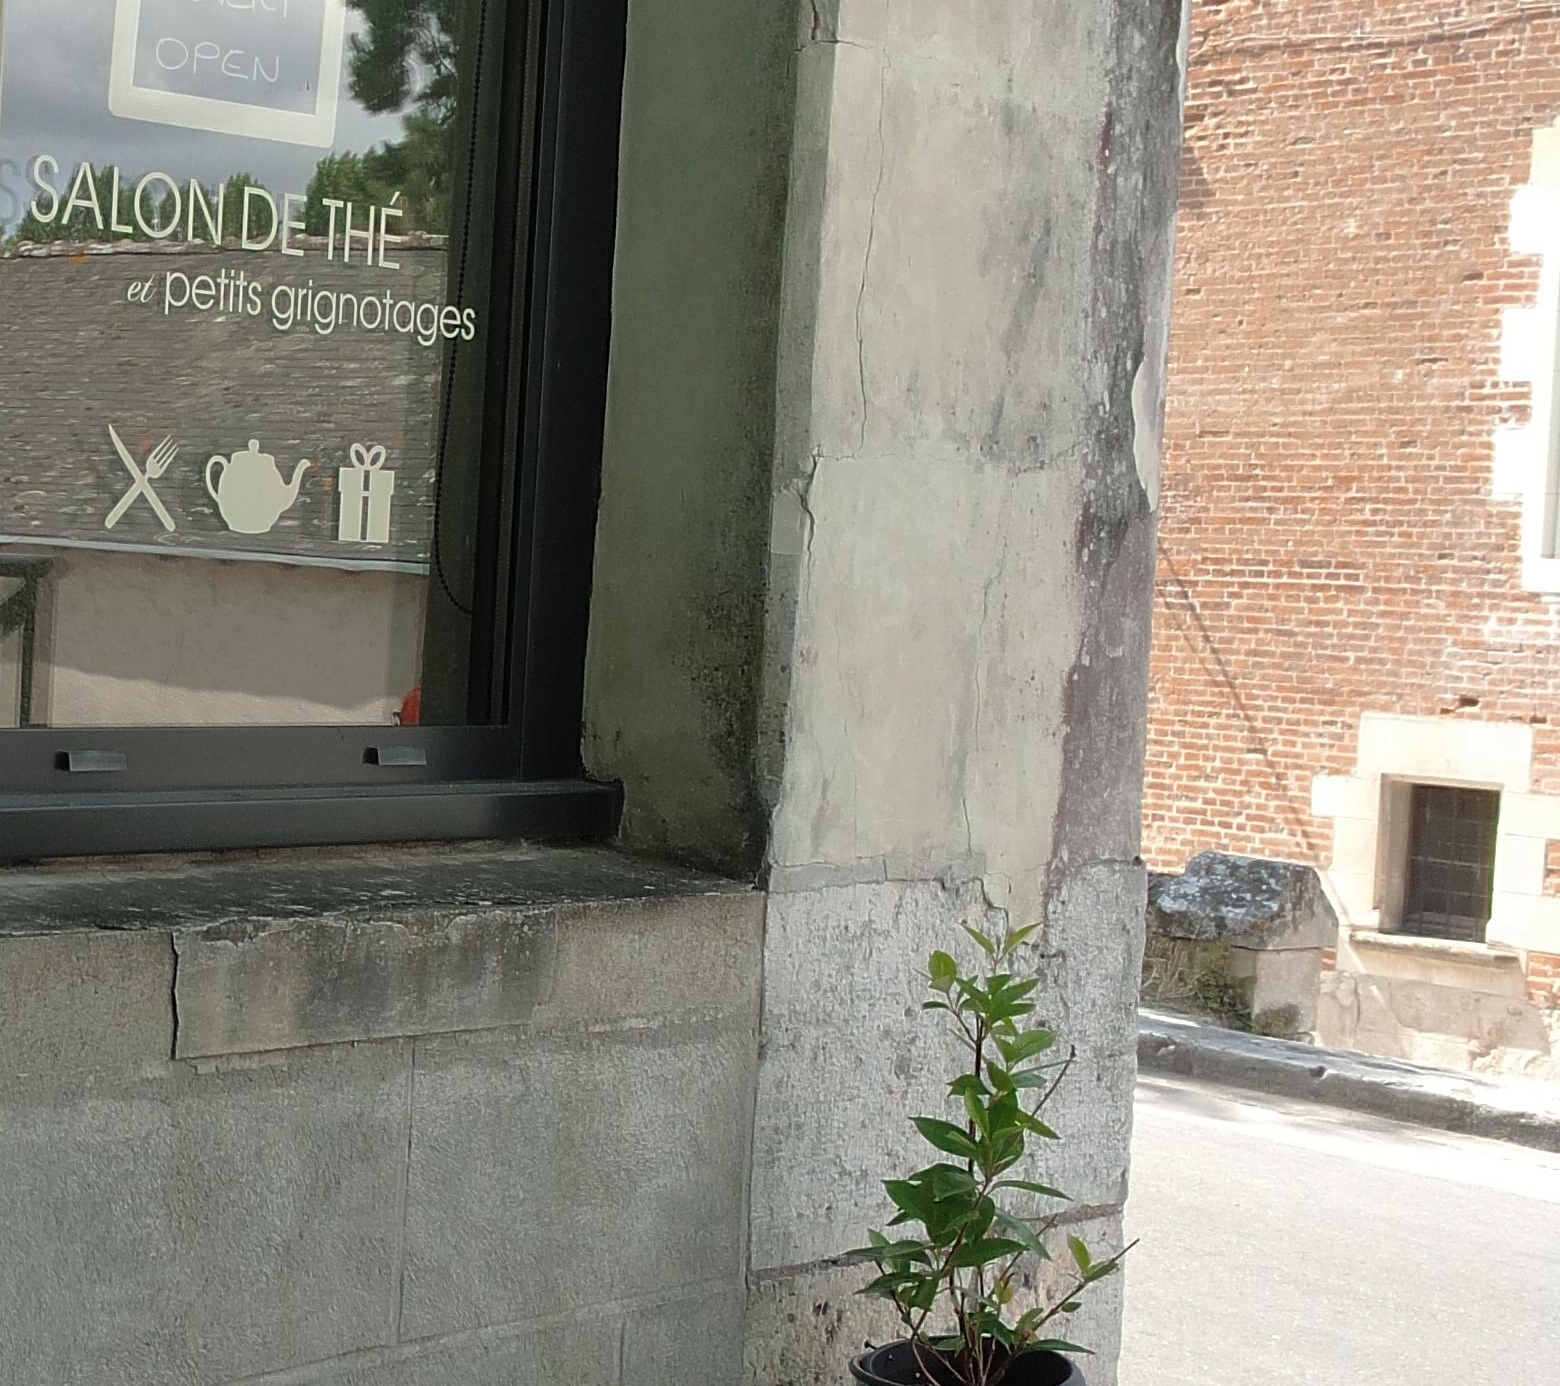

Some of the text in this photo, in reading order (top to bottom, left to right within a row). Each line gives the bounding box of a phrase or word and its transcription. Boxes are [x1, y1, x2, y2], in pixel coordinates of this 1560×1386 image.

[155, 38, 280, 83] OPEN
[30, 154, 403, 269] SALON DE THÉ
[126, 269, 475, 346] et petits grignotages
